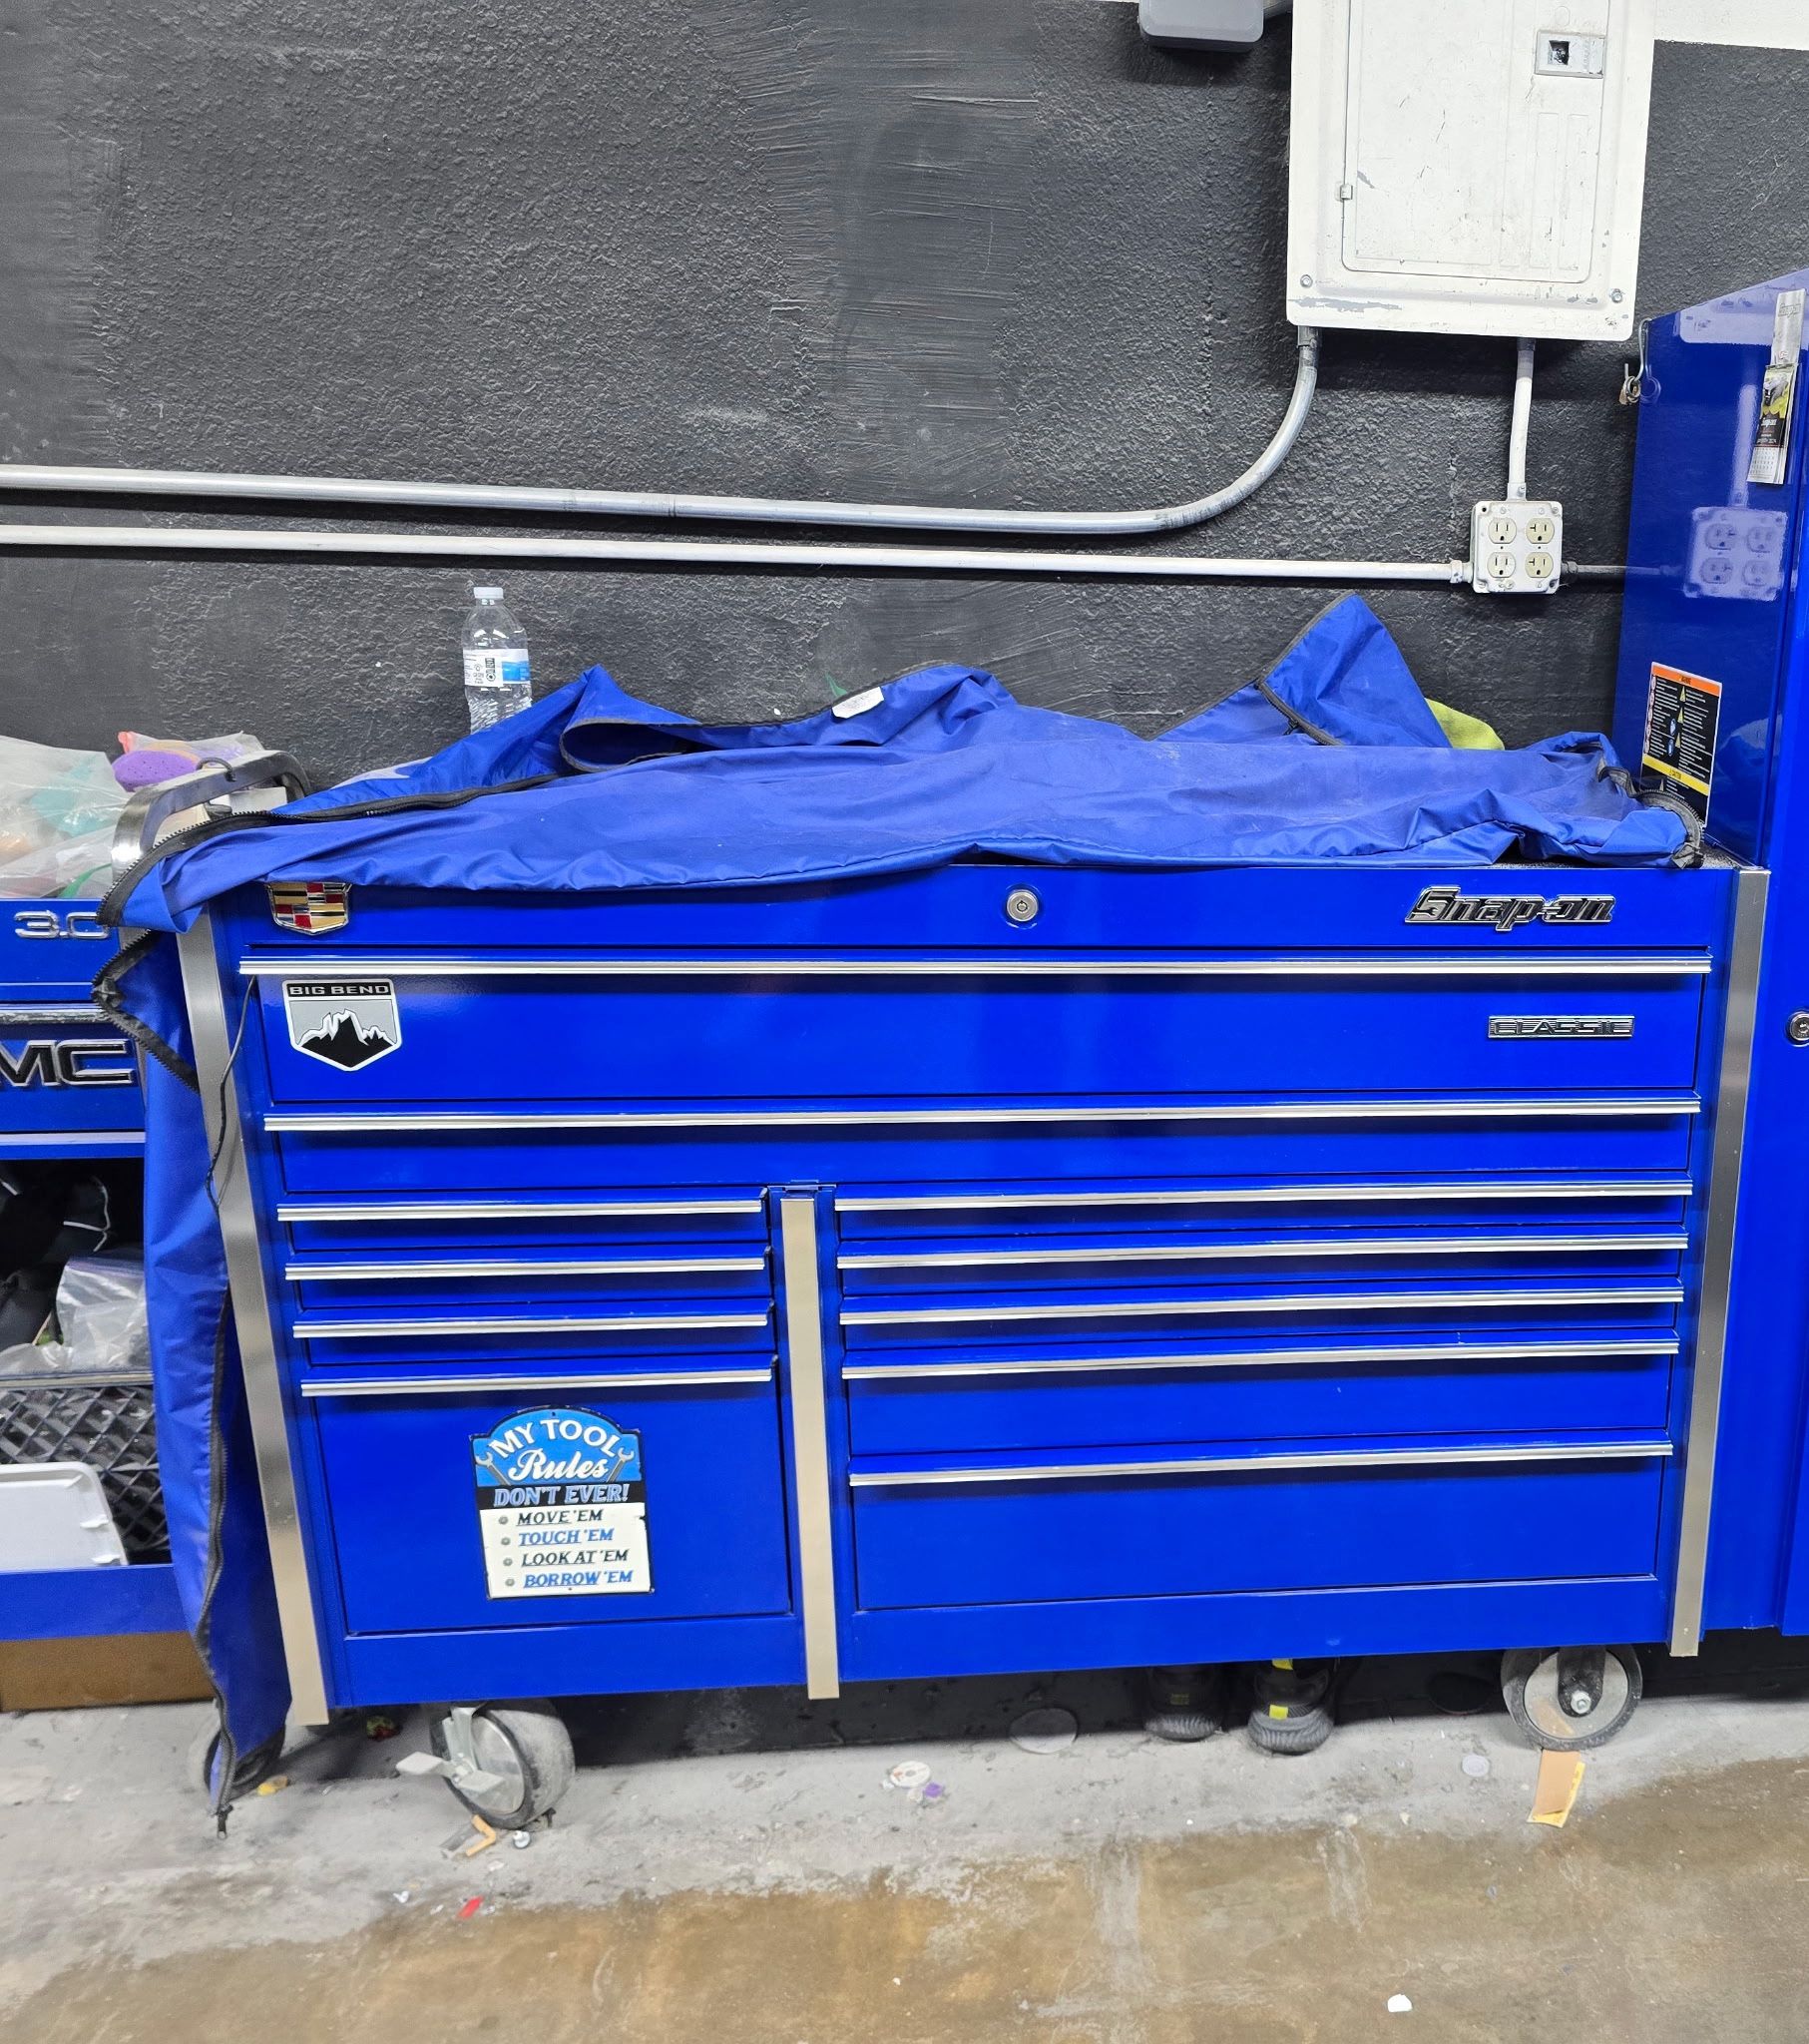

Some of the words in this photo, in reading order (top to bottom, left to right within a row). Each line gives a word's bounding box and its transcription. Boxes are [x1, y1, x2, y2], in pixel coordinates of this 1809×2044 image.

[1405, 884, 1615, 931] Snap-on
[289, 985, 326, 996] BIG
[330, 983, 390, 996] BEND
[1491, 1017, 1632, 1037] CLASSIC
[0, 1039, 136, 1086] MC
[488, 1422, 533, 1459] MY
[541, 1418, 621, 1457] TOOL
[508, 1447, 610, 1482] Rules
[494, 1485, 561, 1507] DON'T
[565, 1484, 629, 1503] EVER!
[517, 1510, 573, 1527] MOVE
[573, 1508, 605, 1523] 'EM
[518, 1529, 583, 1547] TOUCH
[584, 1527, 615, 1543] 'EM
[521, 1550, 574, 1568] LOOK
[573, 1550, 597, 1565] AT
[600, 1548, 631, 1563] 'EM
[523, 1570, 603, 1589] BORROW
[603, 1569, 635, 1584] 'EM
